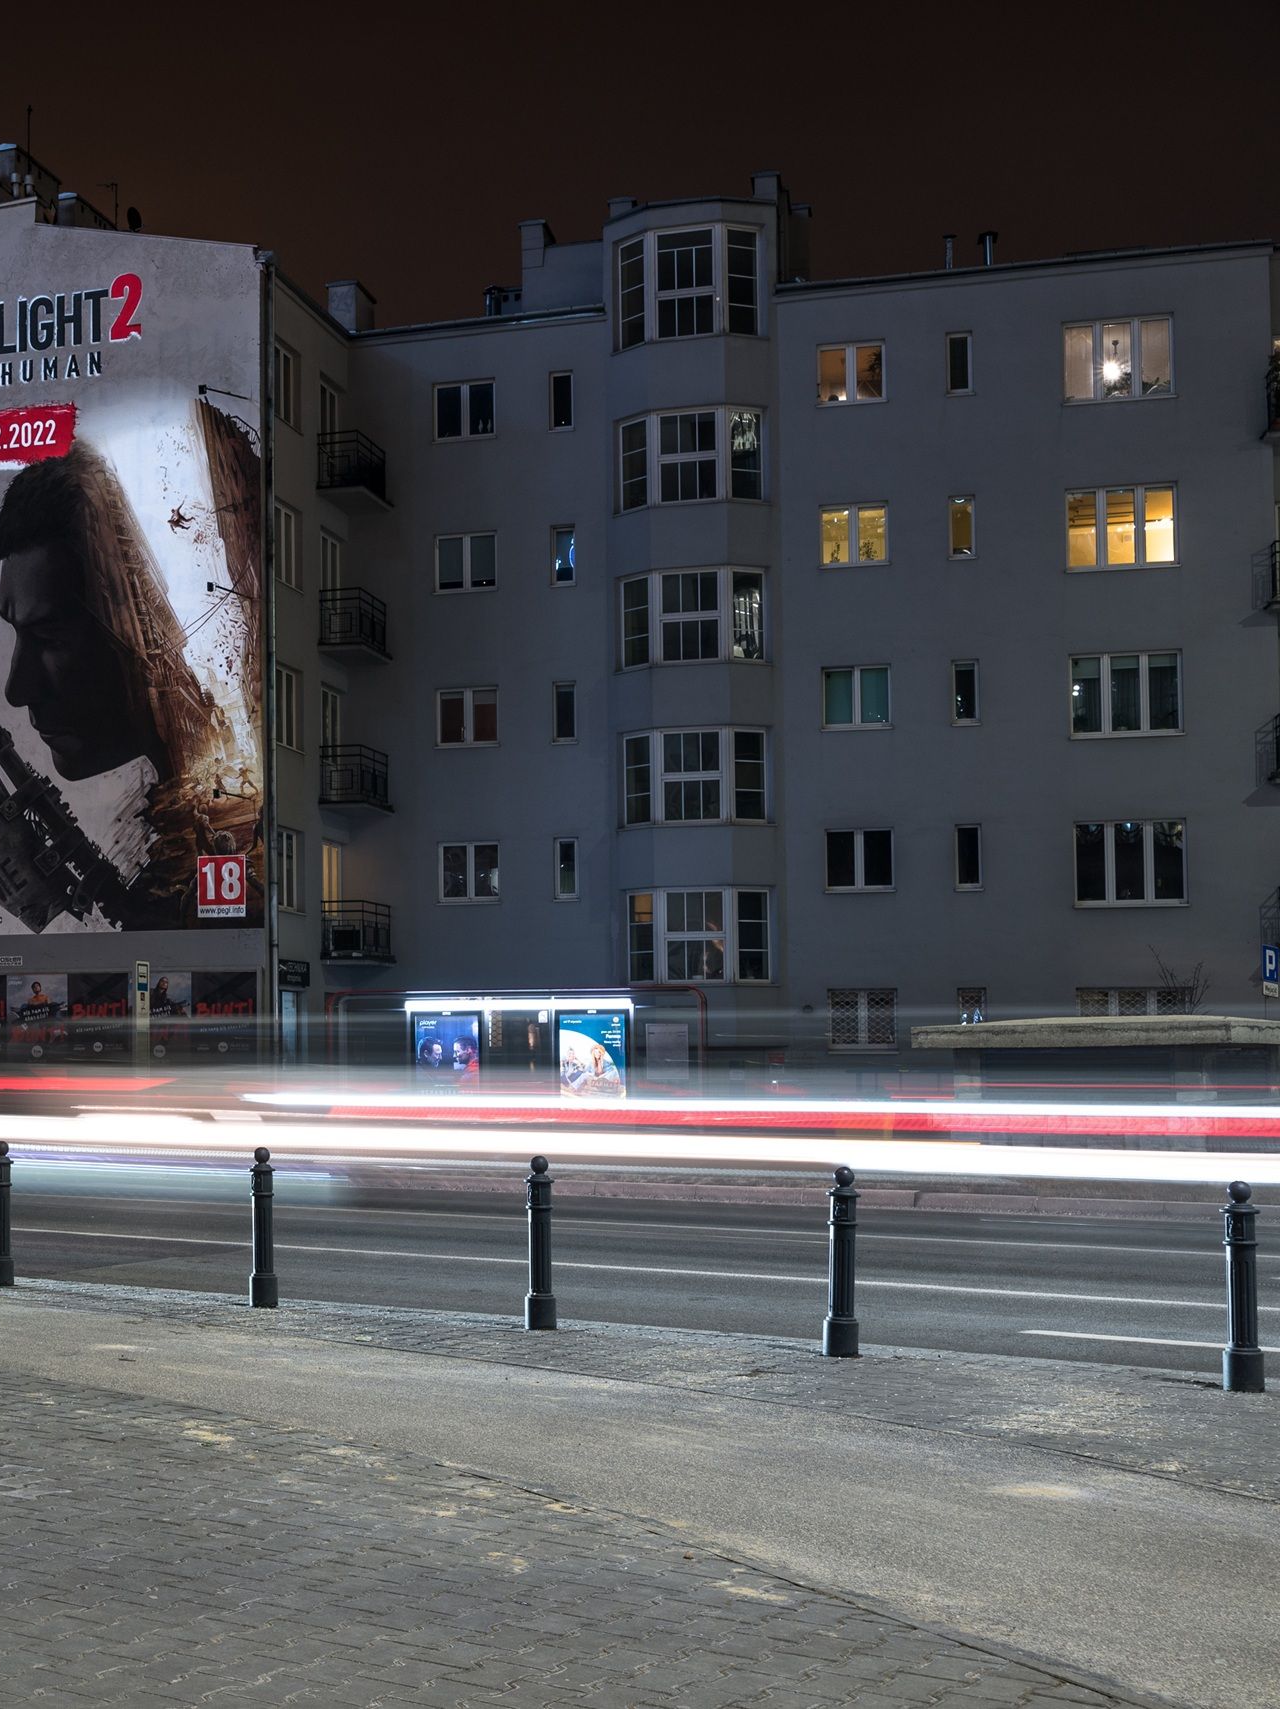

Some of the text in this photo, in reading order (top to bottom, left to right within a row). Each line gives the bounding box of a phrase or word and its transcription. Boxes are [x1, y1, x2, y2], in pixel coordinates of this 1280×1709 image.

[0, 351, 103, 387] HUMAN
[201, 861, 242, 900] 18
[200, 906, 245, 915] www.pegi.info
[1265, 949, 1276, 977] P
[69, 998, 127, 1020] BUNT!
[195, 998, 255, 1019] BUNT!
